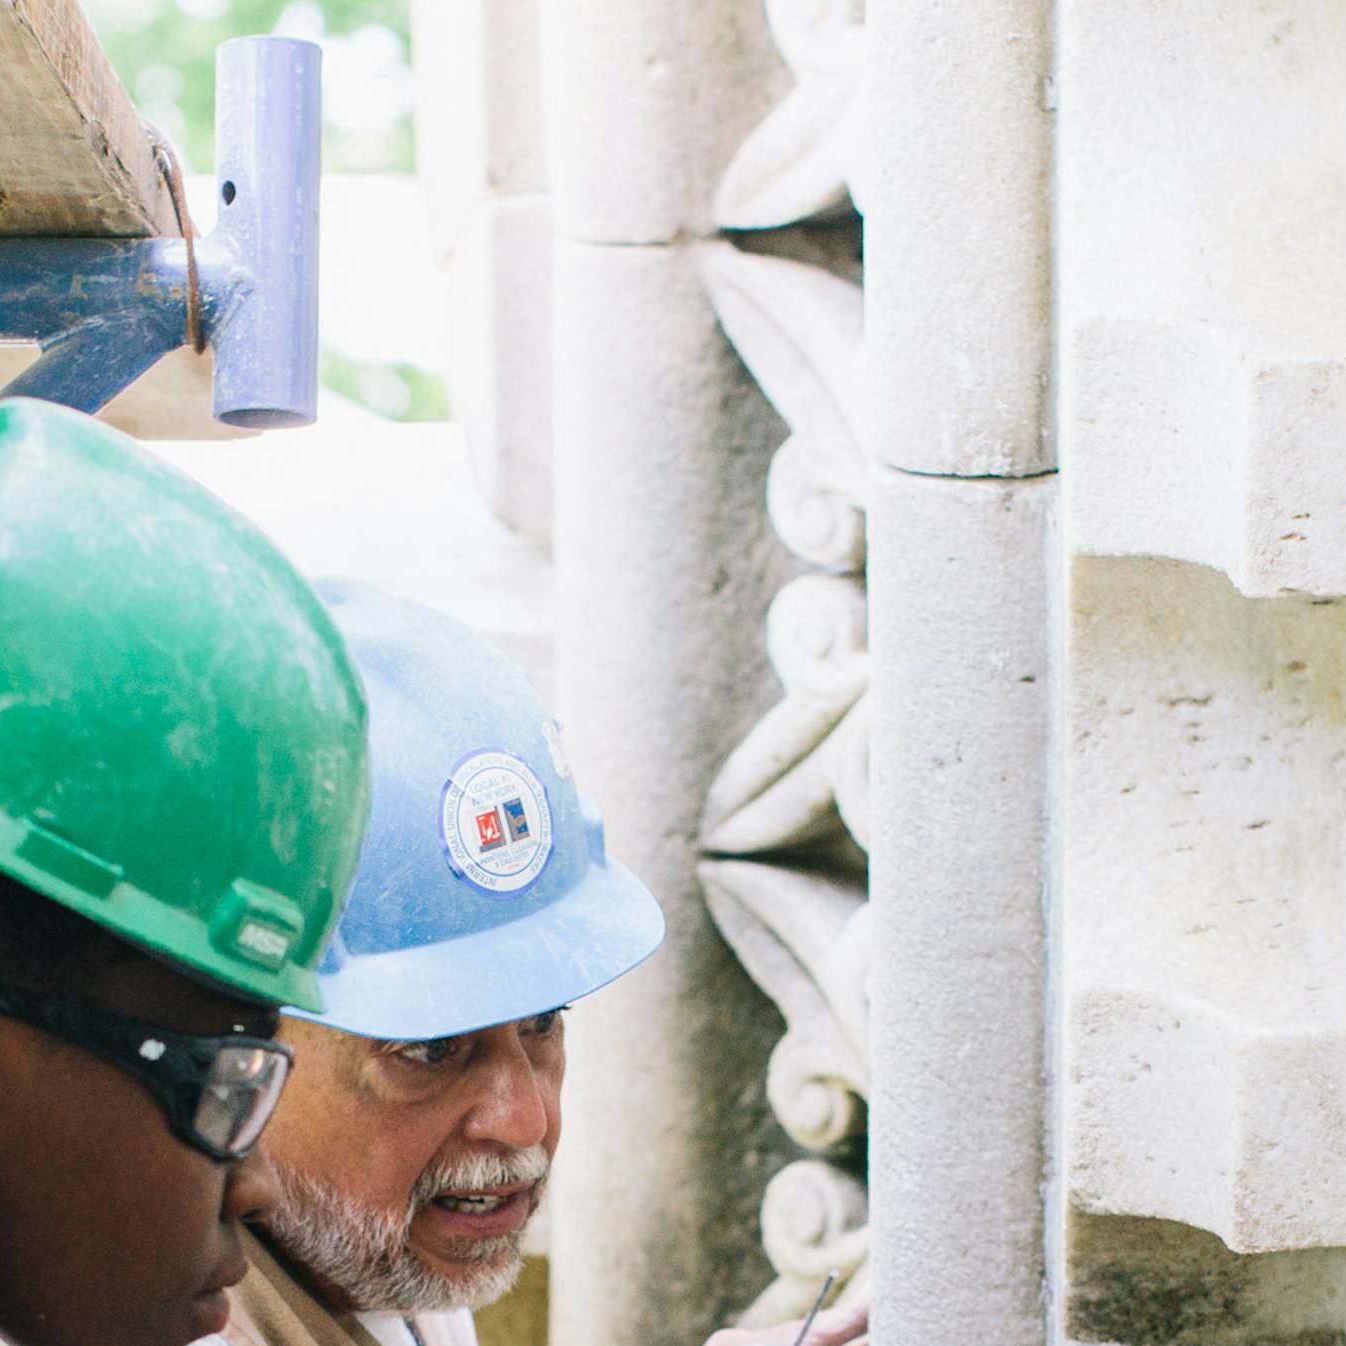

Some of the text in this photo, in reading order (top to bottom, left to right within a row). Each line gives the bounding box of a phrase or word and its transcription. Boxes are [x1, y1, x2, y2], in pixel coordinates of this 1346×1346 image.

[470, 777, 500, 794] LOCAL
[471, 791, 493, 807] NEW
[445, 800, 456, 830] UNION
